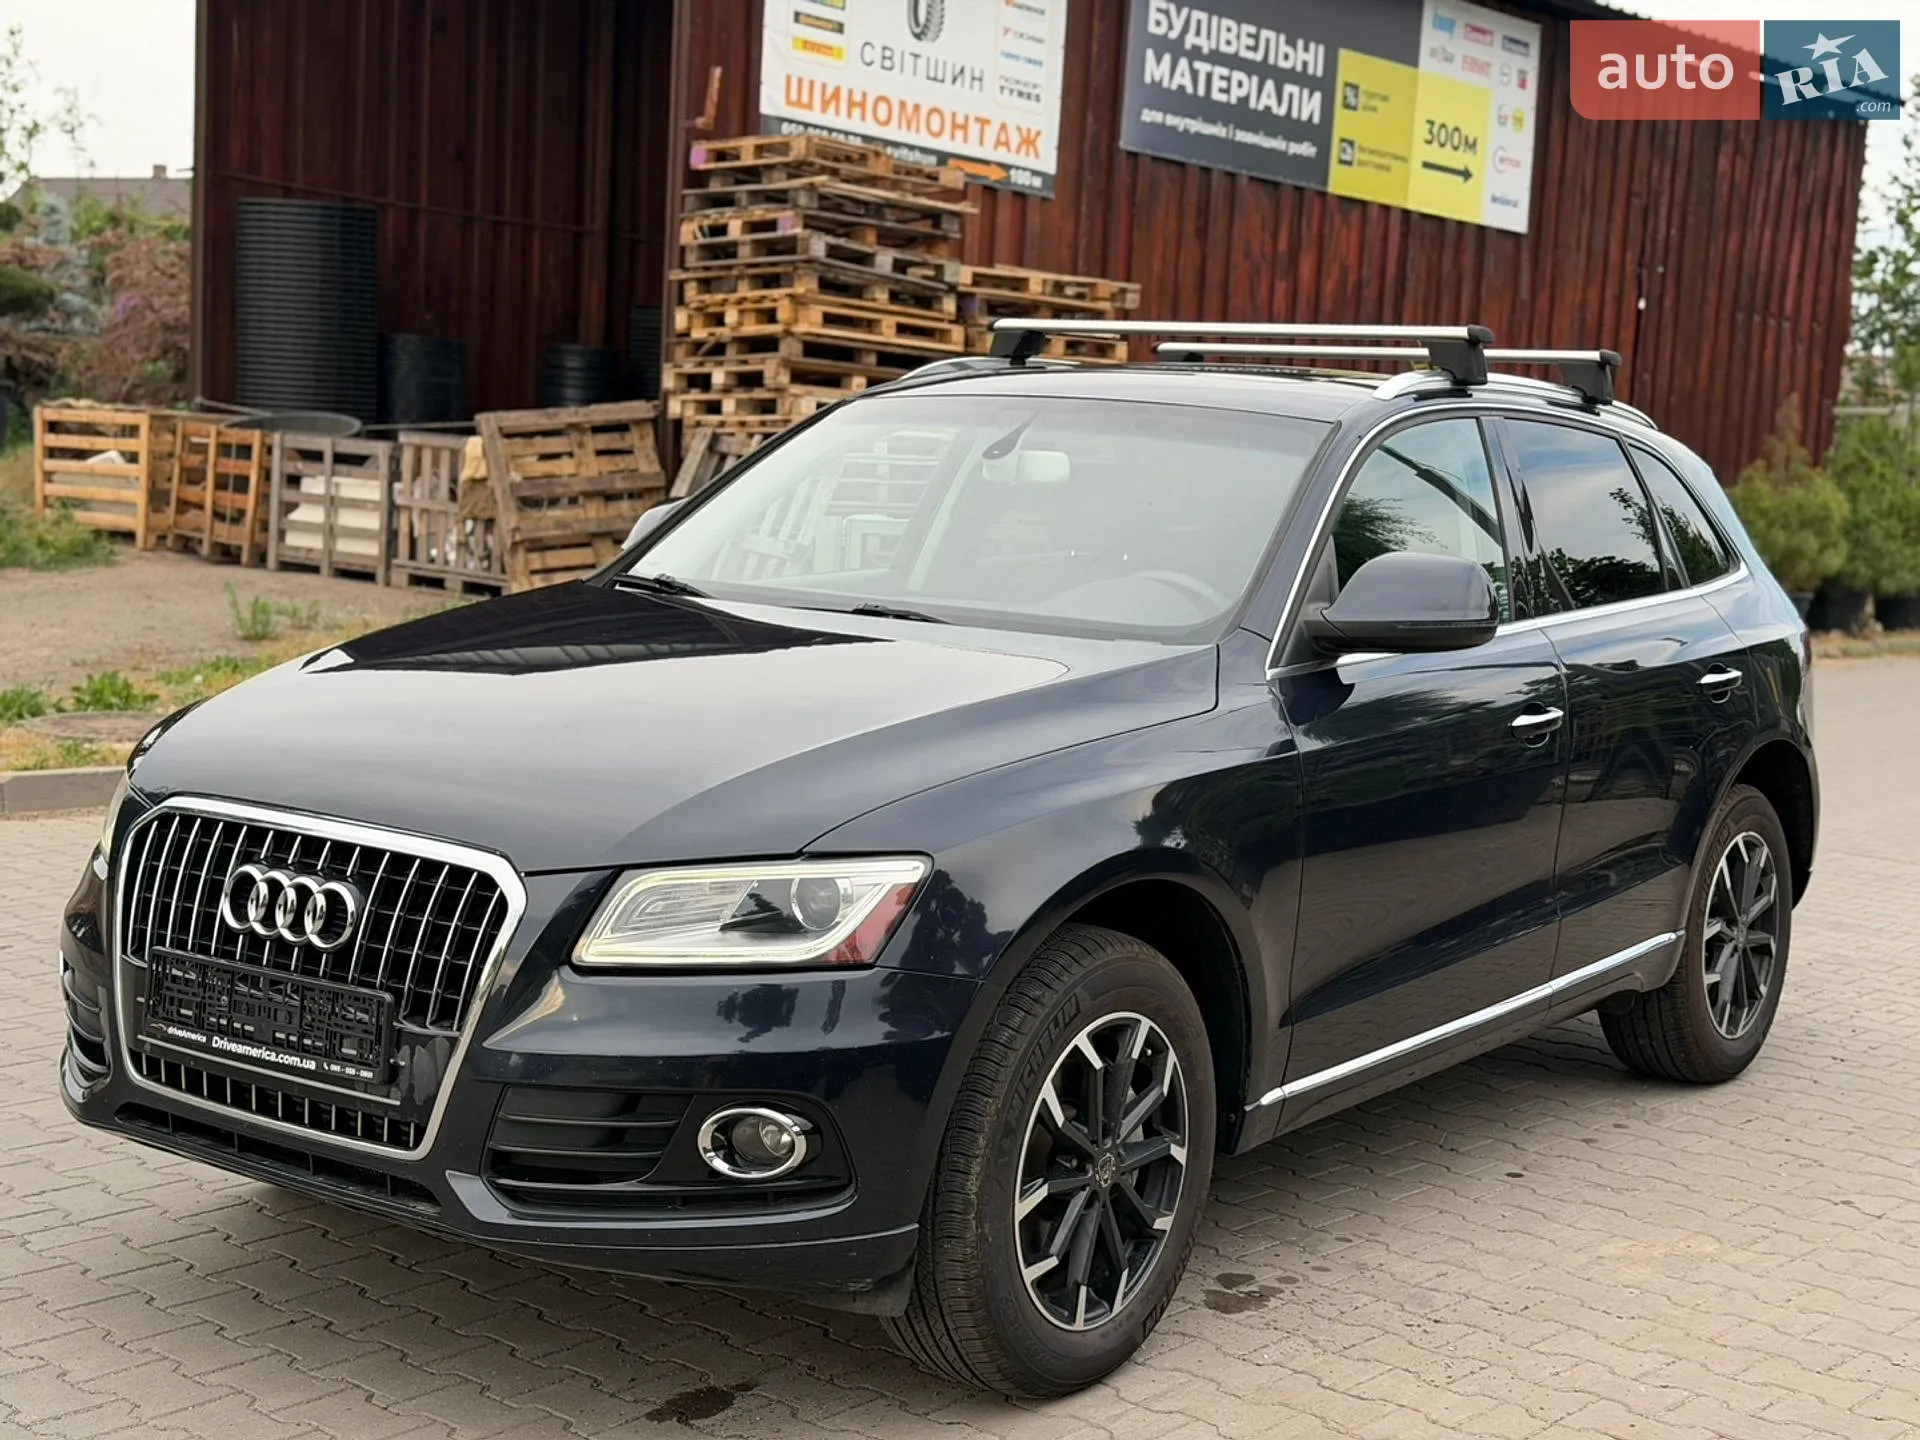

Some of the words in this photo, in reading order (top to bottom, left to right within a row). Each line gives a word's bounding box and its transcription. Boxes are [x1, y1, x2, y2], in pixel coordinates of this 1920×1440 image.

[859, 41, 985, 93] СВІТШИН
[1147, 0, 1326, 78] БУДІВЕЛЬНІ
[784, 73, 1043, 159] ШИНОМОНТАЖ
[1143, 48, 1322, 125] МАТЕРІАЛИ
[1423, 119, 1478, 156] 300м
[211, 1035, 316, 1071] Driveamerica.com.ua
